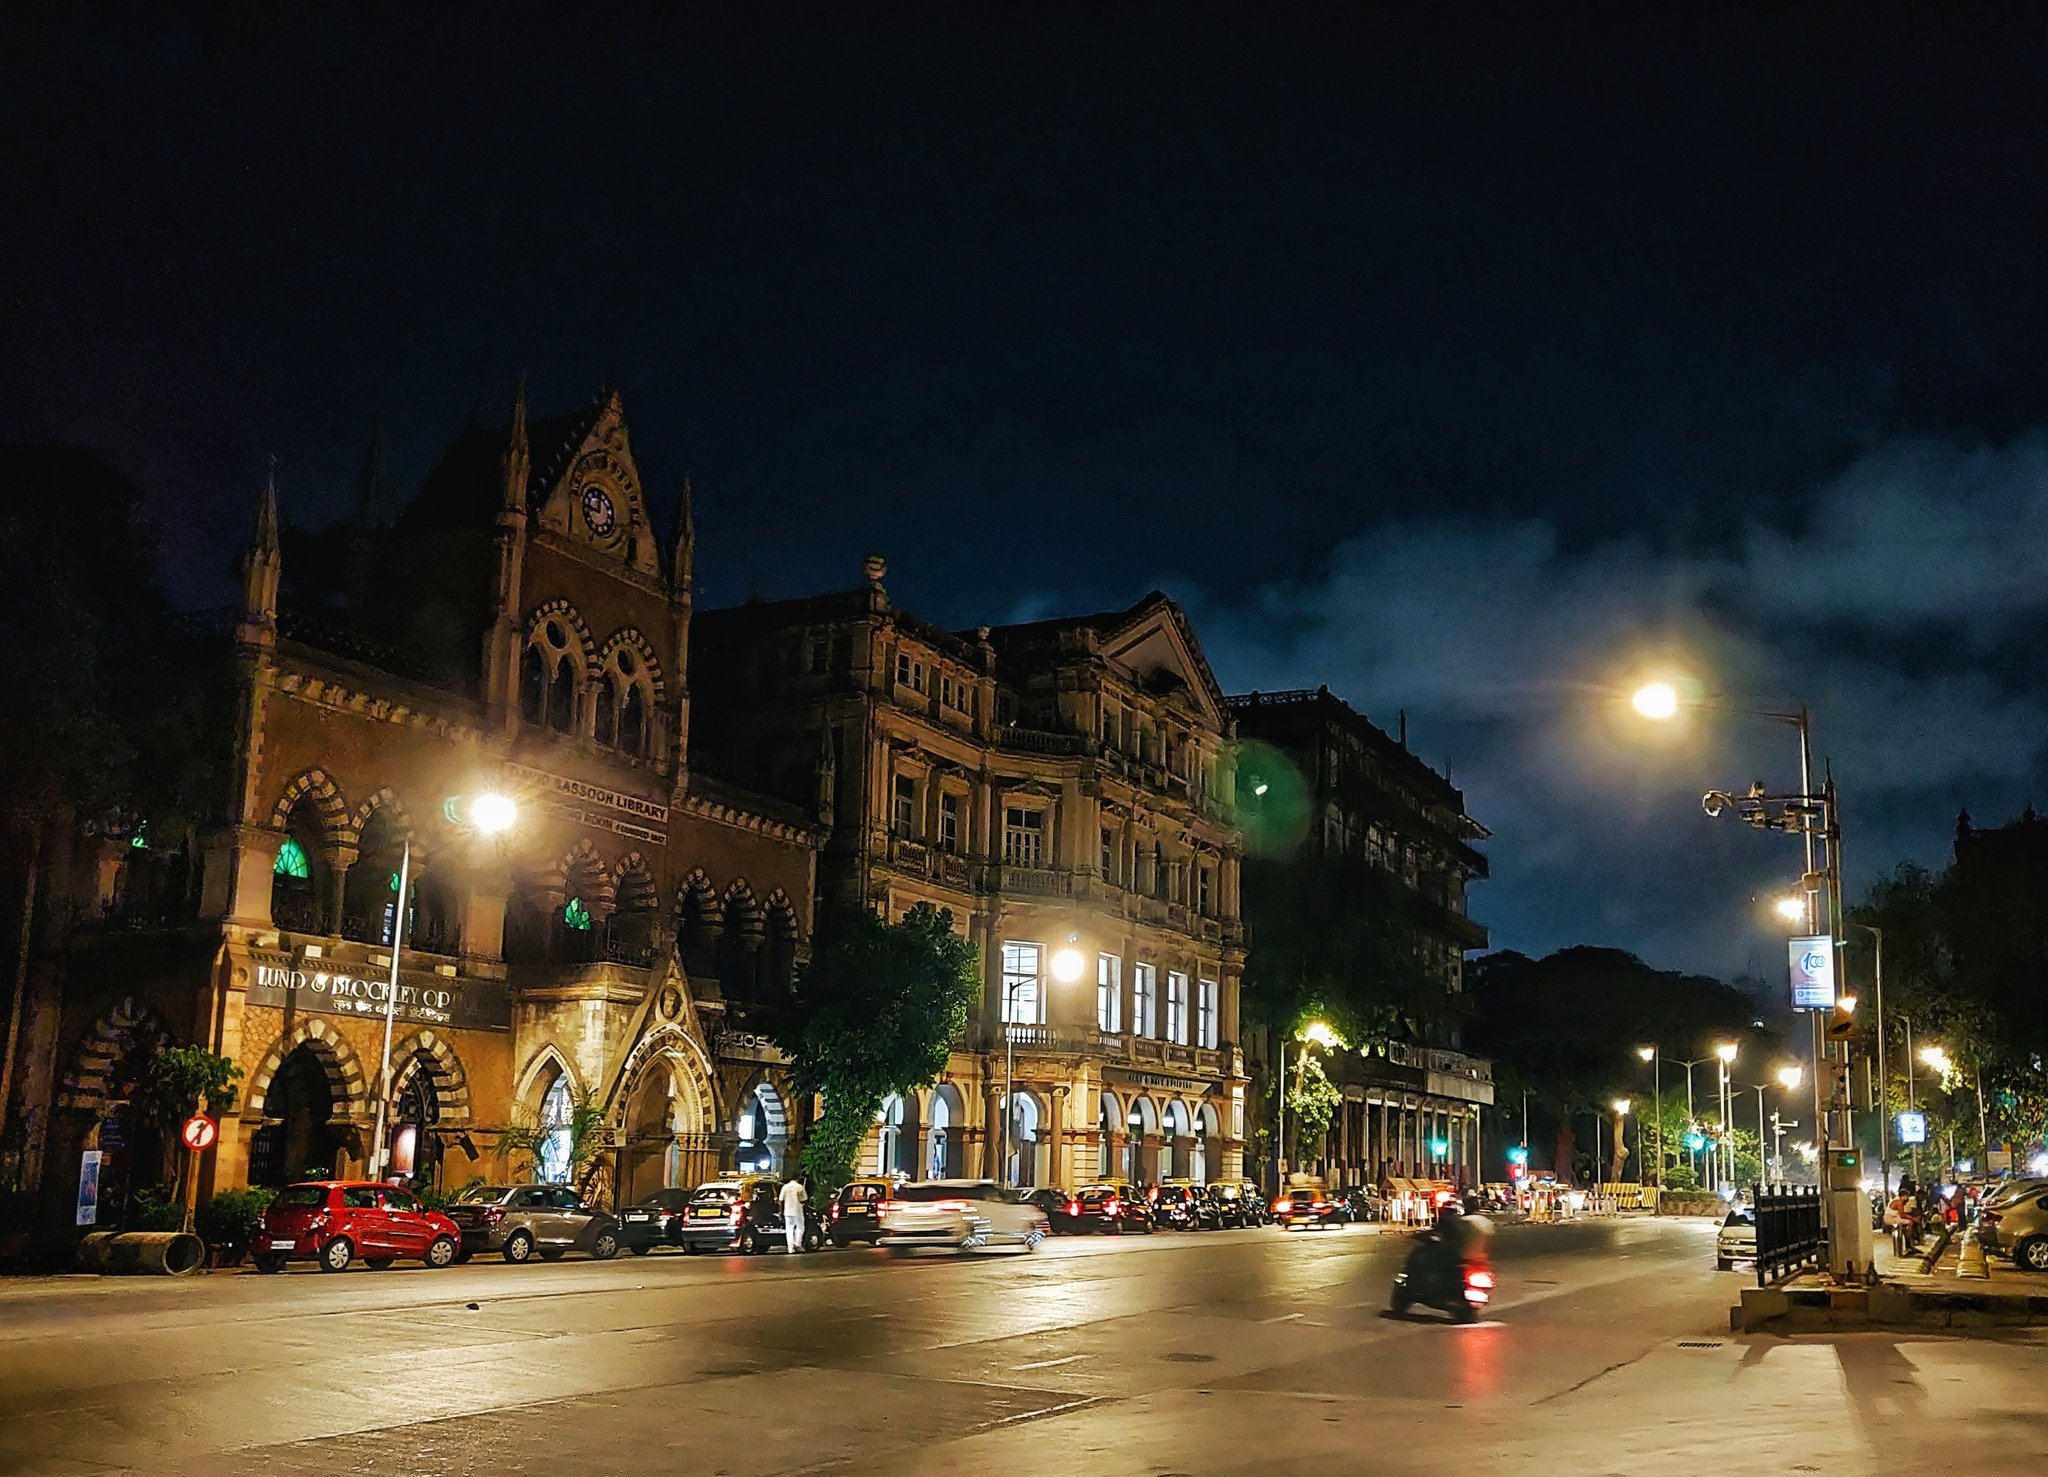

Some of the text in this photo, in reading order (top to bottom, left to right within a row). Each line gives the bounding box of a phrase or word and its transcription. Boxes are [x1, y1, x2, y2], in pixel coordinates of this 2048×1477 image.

[616, 796, 666, 819] LIBRARY
[257, 966, 306, 990] LUND
[311, 972, 329, 992] &
